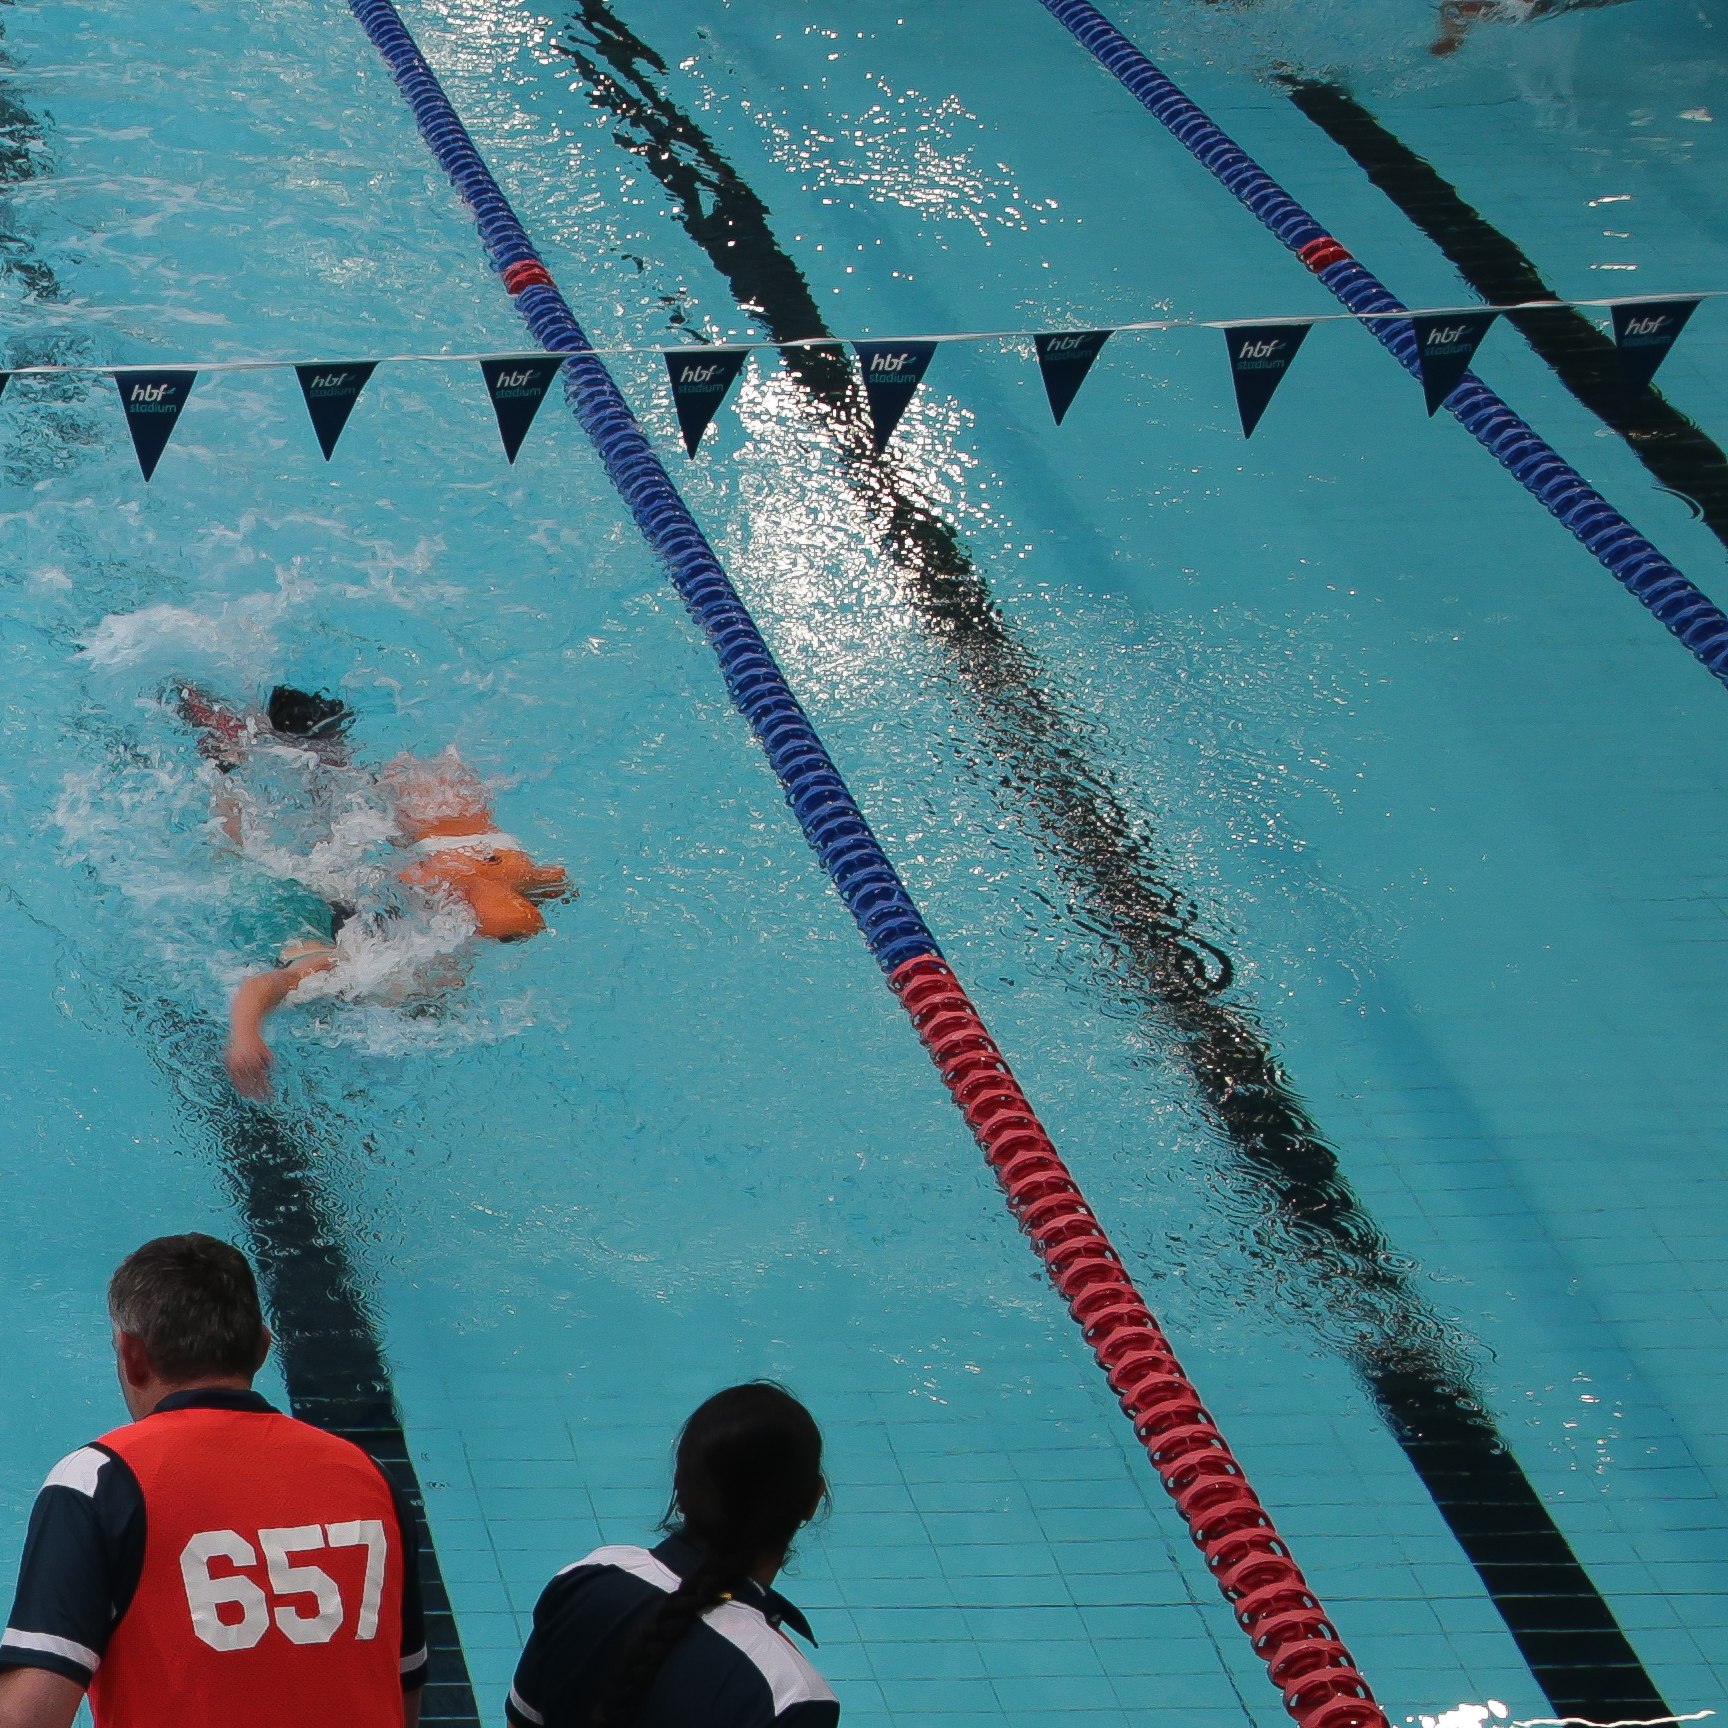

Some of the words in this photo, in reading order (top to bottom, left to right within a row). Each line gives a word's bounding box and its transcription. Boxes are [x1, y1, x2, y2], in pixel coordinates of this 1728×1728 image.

[1624, 315, 1666, 336] hbf
[1046, 335, 1087, 352] hbf
[1426, 325, 1467, 345] hbf
[1239, 339, 1280, 359] hbf
[1424, 343, 1472, 356] stadium
[870, 353, 909, 372] hbf
[1236, 358, 1285, 370] stadium
[311, 372, 348, 388] hbf
[496, 370, 534, 389] hbf
[680, 365, 718, 383] hbf
[868, 372, 916, 383] stadium
[130, 384, 168, 402] hbf
[495, 386, 541, 399] stadium
[677, 383, 724, 394] stadium
[130, 402, 177, 413] stadium
[180, 1519, 387, 1652] 657
